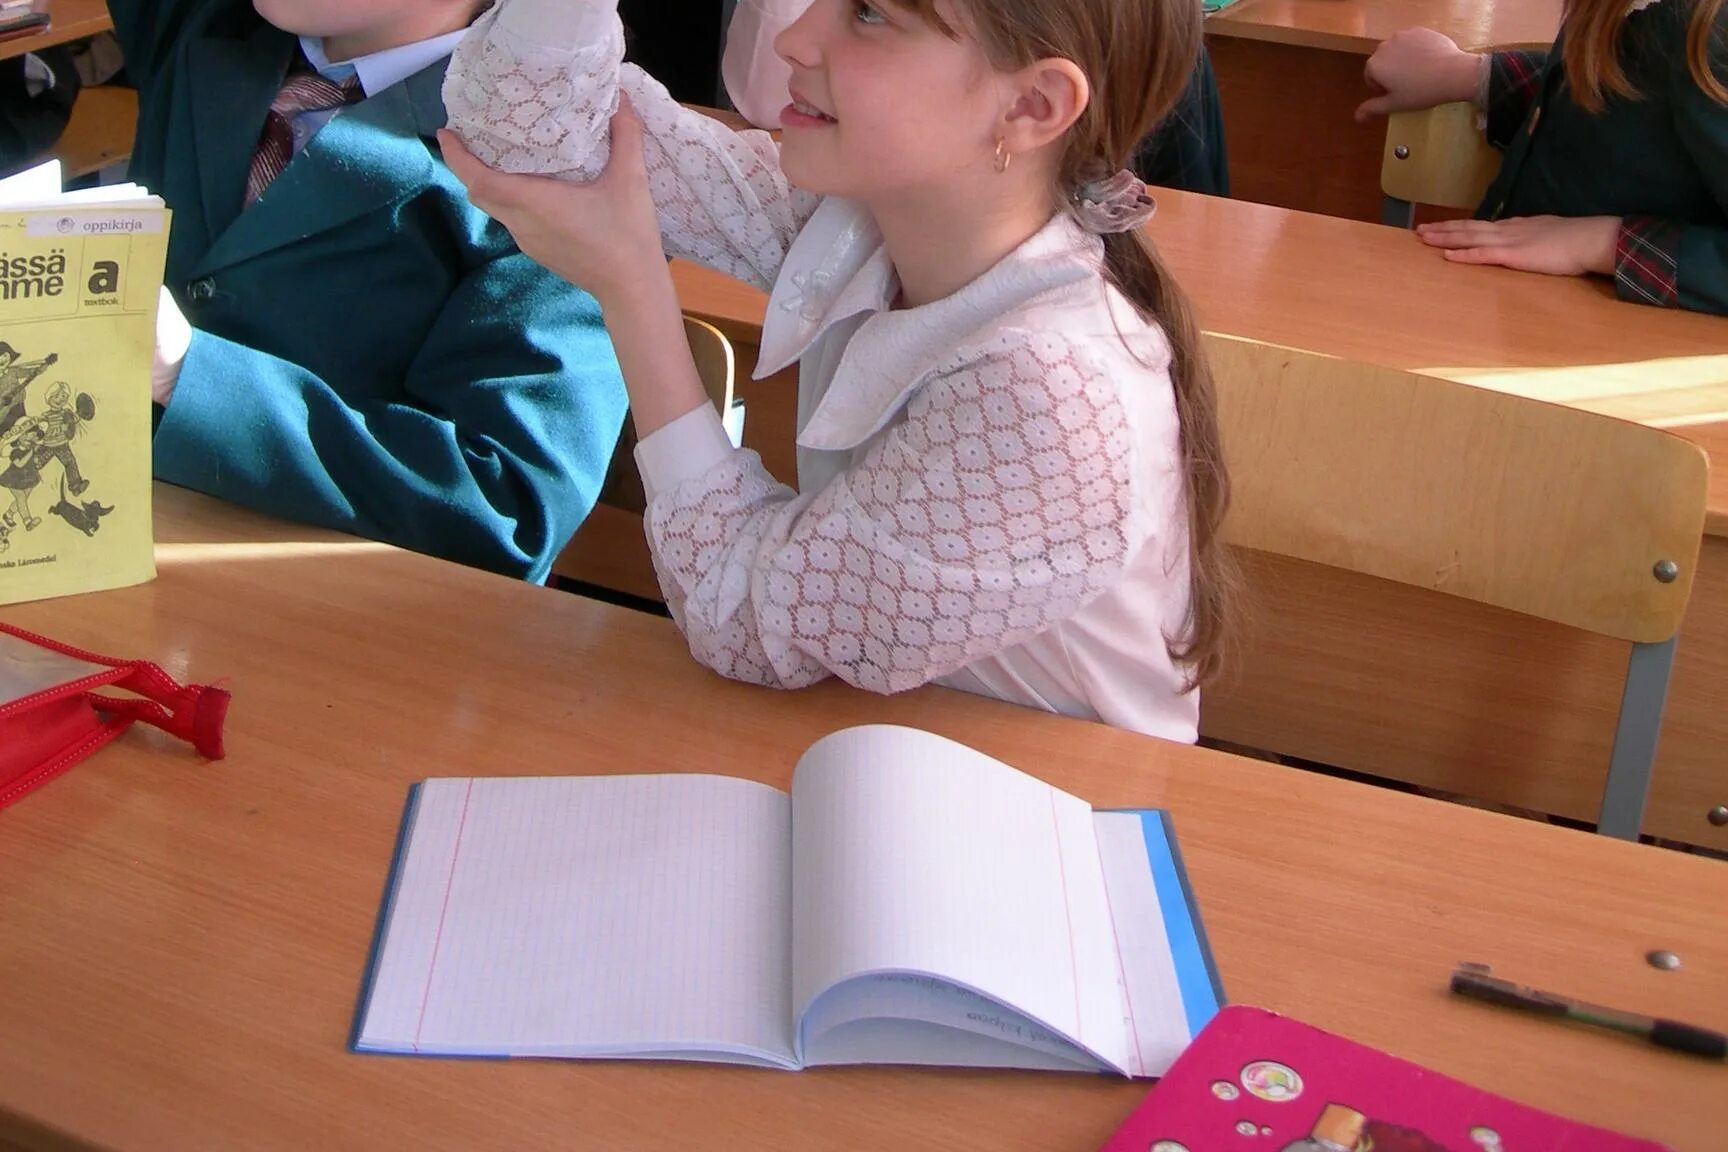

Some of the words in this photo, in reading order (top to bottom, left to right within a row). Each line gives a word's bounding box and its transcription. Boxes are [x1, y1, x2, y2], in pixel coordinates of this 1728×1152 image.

[83, 219, 143, 233] oppikirja
[0, 275, 64, 300] me
[88, 260, 119, 295] a
